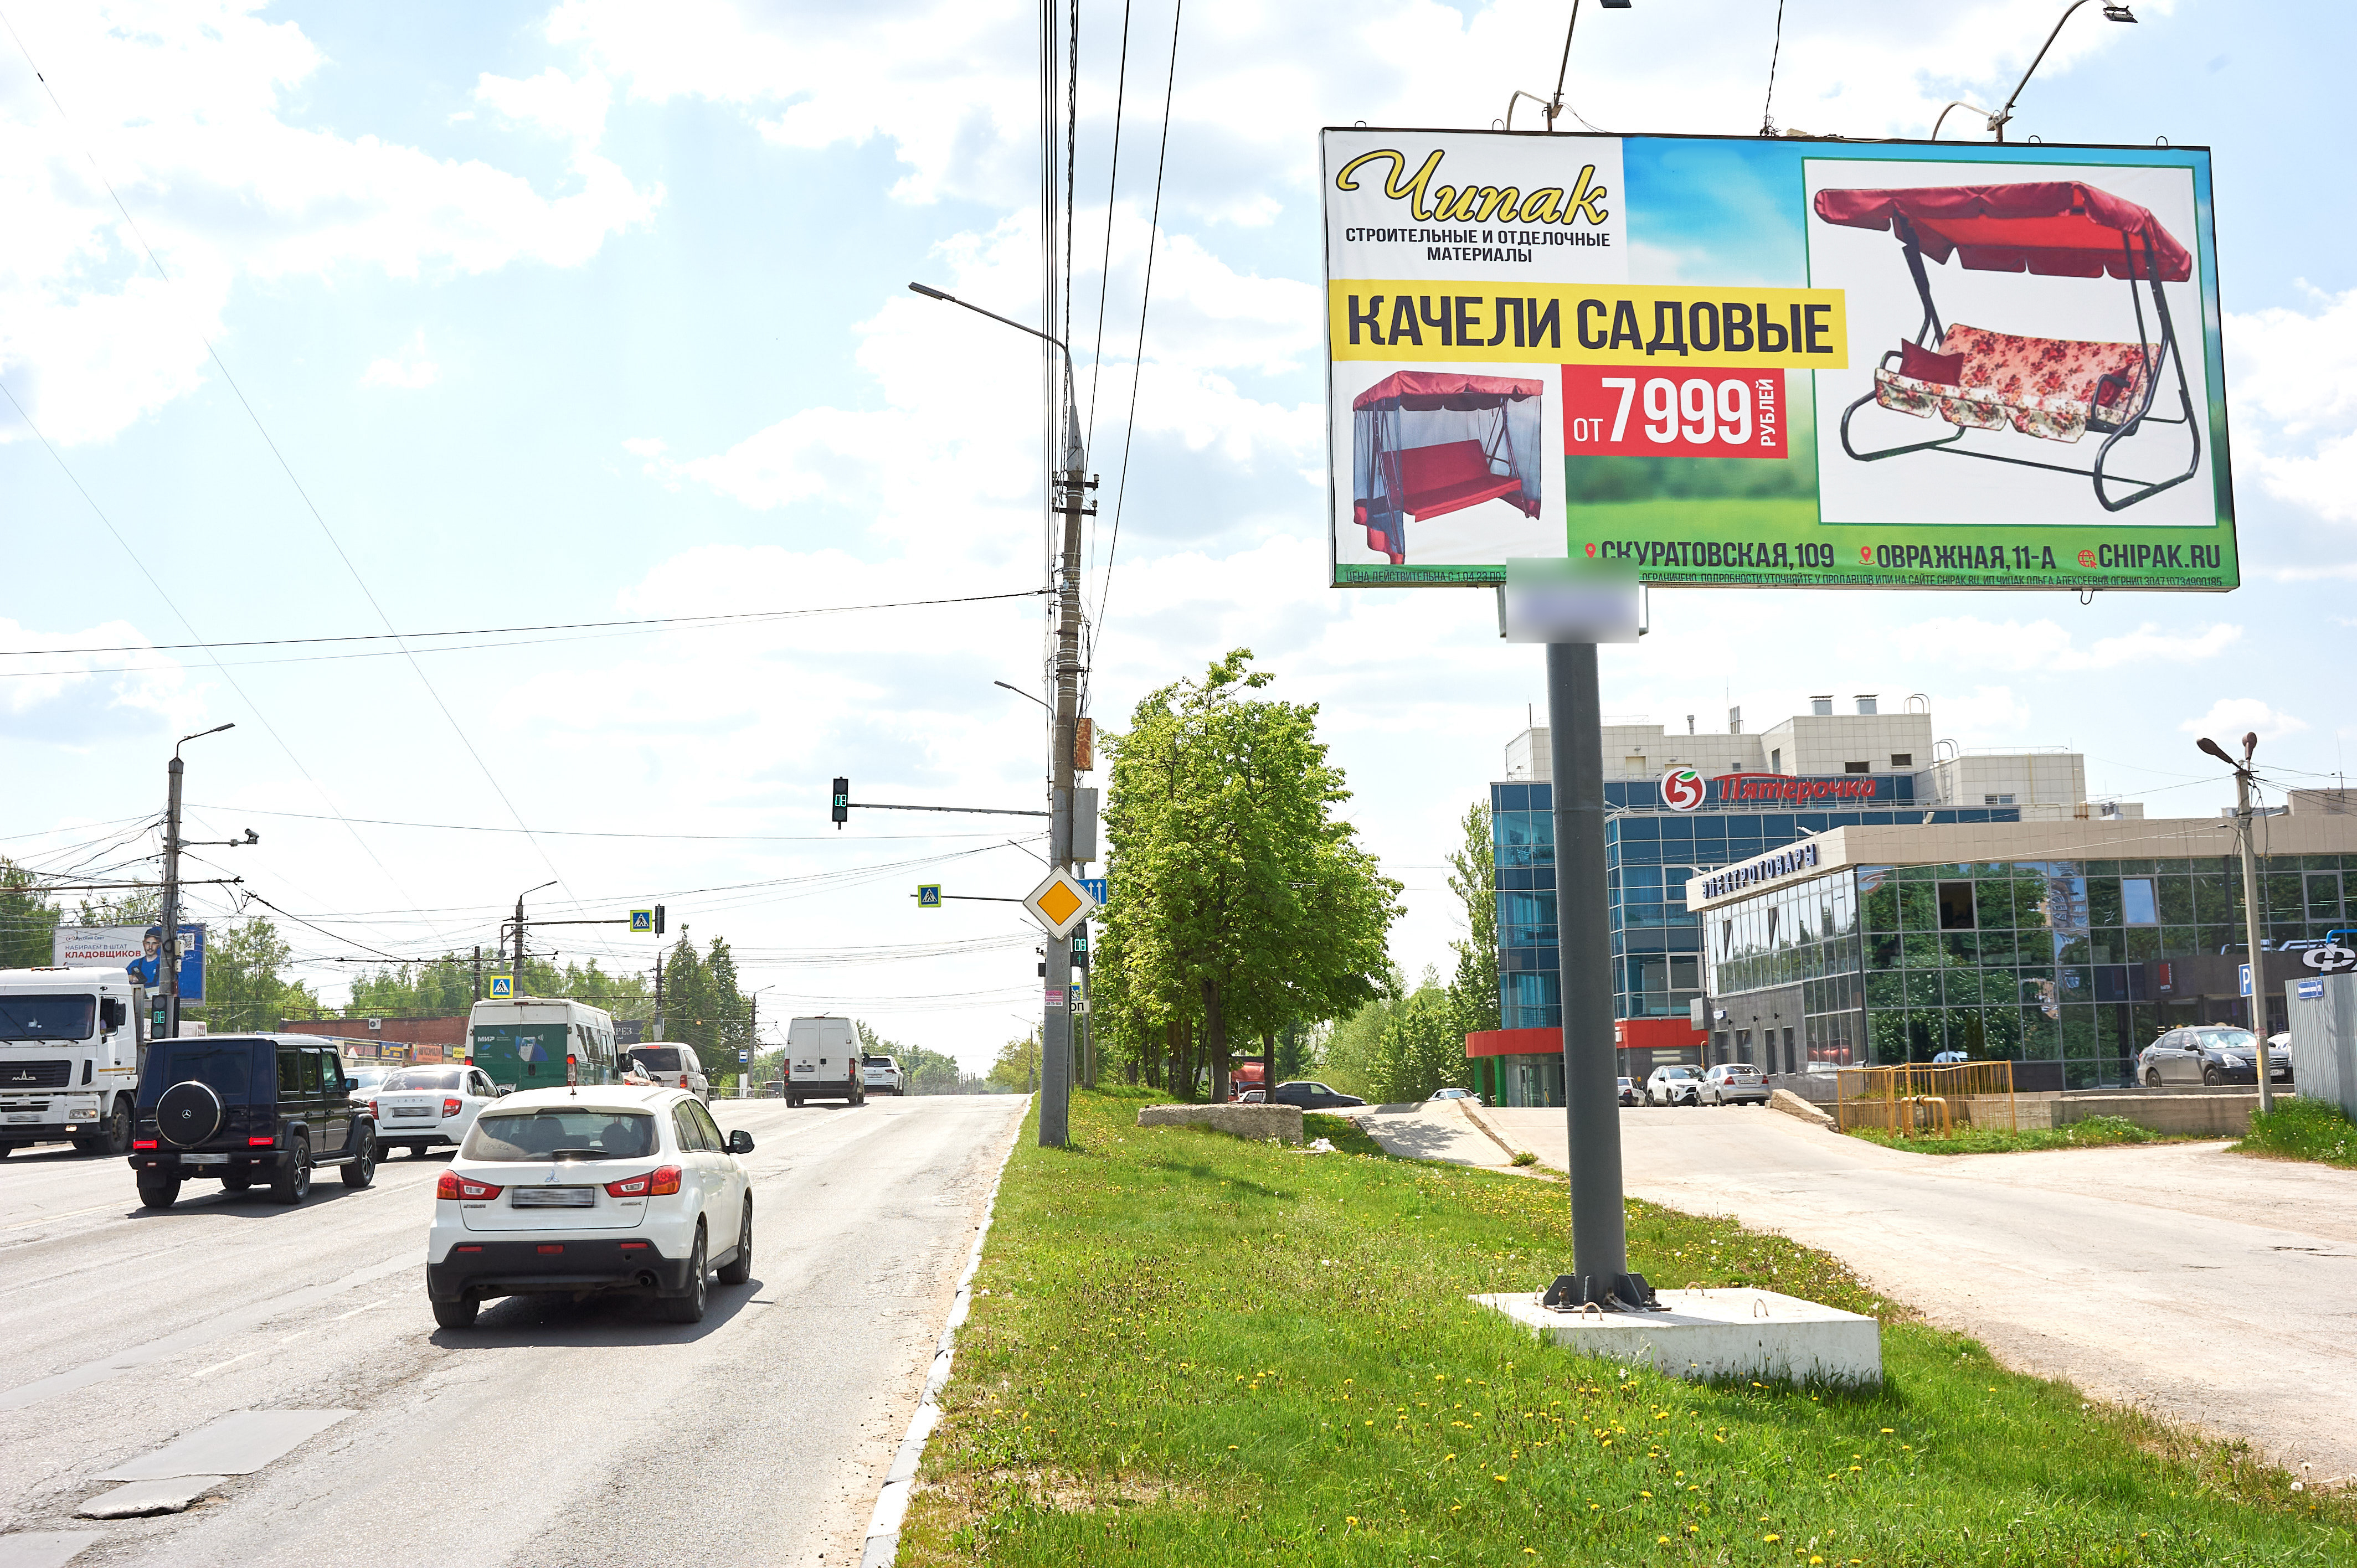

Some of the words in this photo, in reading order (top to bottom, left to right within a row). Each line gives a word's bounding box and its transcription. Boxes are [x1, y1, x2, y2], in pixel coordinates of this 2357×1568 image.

[1335, 148, 1609, 225] Чипак
[1345, 228, 1478, 244] СТРОИТЕЛЬНЫЕ
[1483, 230, 1494, 244] И
[1497, 230, 1610, 246] ОТДЕЛОЧНЫЕ
[1427, 247, 1532, 262] МАТЕРИАЛЫ
[1348, 295, 1561, 348] КАЧЕЛИ
[1576, 298, 1834, 357] САДОВЫЕ
[1755, 379, 1776, 446] РУБЛЕЙ
[1573, 417, 1604, 442] ОТ
[2098, 543, 2221, 569] CHIPAK.RU
[1346, 571, 1370, 582] ЦЕНА
[1895, 575, 1906, 584] НА
[1712, 772, 1876, 805] Пятёрочка
[1701, 843, 1817, 900] ЭЛЕКТРОТОВАРЫ
[65, 950, 141, 959] КЛАДОВЩИКОВ
[1071, 1002, 1084, 1012] ОП
[615, 1027, 632, 1035] РЕЗ
